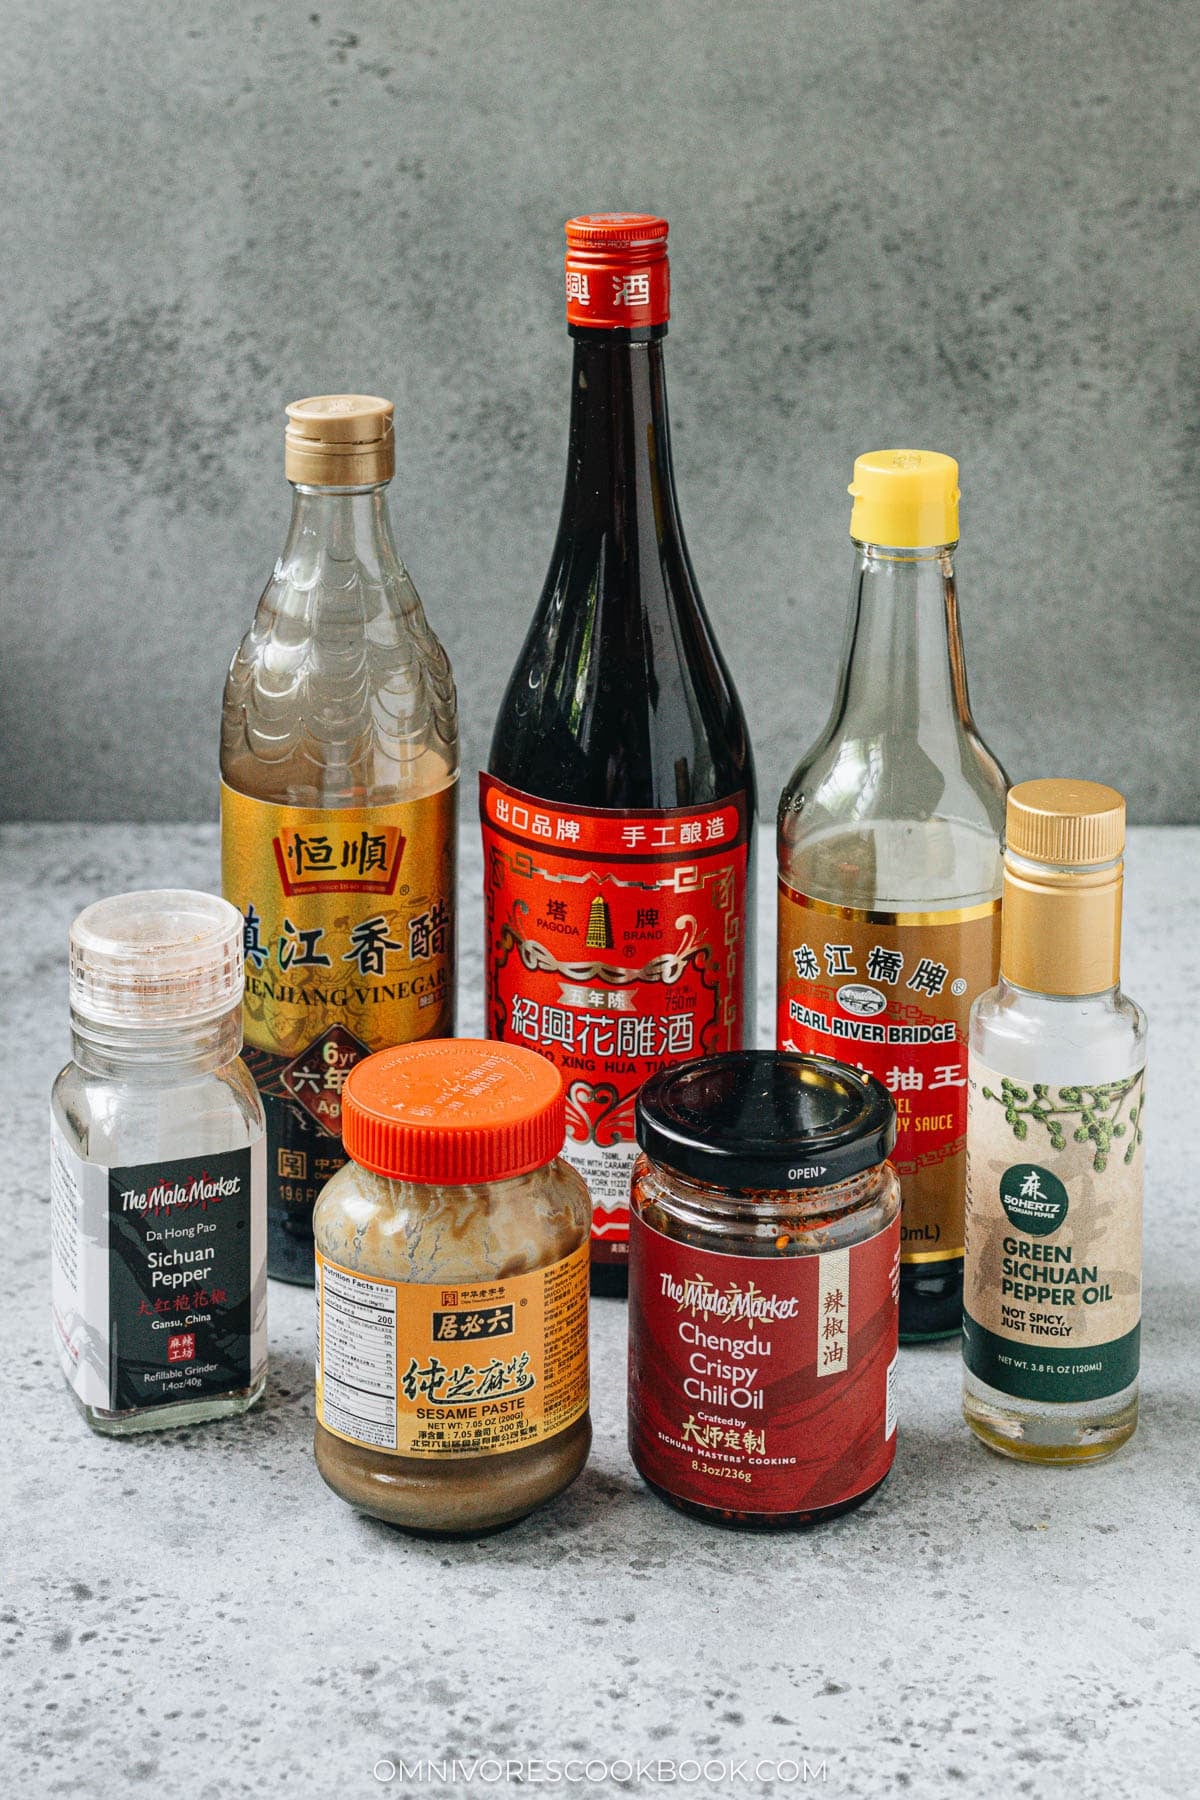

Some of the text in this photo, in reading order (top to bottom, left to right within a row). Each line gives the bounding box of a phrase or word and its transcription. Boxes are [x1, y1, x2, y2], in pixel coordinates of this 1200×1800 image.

[496, 798, 726, 848] 出口品牌 手工酿造
[635, 908, 659, 929] 牌
[537, 919, 663, 941] PAGODA BRAND
[793, 944, 949, 997] 珠江橋牌
[511, 994, 694, 1058] 紹興花雕酒
[789, 1000, 956, 1044] PEARL RIVER BRIDGE
[323, 1042, 356, 1064] 6yr
[561, 1055, 595, 1071] XING
[605, 1062, 637, 1074] HUA
[317, 1101, 341, 1117] Ag
[915, 1113, 953, 1132] SAUCE
[587, 1159, 602, 1167] WITH
[788, 1166, 819, 1180] OPEN
[121, 1176, 241, 1211] The Mala Market
[280, 1185, 303, 1202] 19.6
[146, 1223, 217, 1242] Da Hong Pao
[147, 1247, 215, 1268] Sichuan
[1002, 1237, 1072, 1263] GREEN
[152, 1267, 212, 1289] Pepper
[324, 1265, 350, 1283] Nutrition
[353, 1279, 373, 1290] Facts
[1002, 1258, 1098, 1285] SICHUAN
[660, 1272, 799, 1320] The Mala Market
[1002, 1278, 1113, 1306] PEPPER OIL
[151, 1314, 212, 1330] Gansu, China
[378, 1315, 393, 1325] 200
[823, 1289, 846, 1365] 辣椒油
[1001, 1305, 1066, 1327] NOT SPICY,
[1001, 1317, 1072, 1337] JUST TINGLY
[678, 1322, 772, 1360] Chengdu
[144, 1363, 218, 1383] Refillable Grinder
[690, 1352, 758, 1387] Crispy
[998, 1354, 1103, 1375] NET WT. 3.8 FL OZ (120ML)
[162, 1378, 202, 1392] 1.4oz/40g
[683, 1378, 764, 1410] Chili Oil
[416, 1407, 477, 1420] SESAME
[482, 1397, 525, 1416] PASTE
[428, 1411, 524, 1430] NET WT: 7.05 OZ (200G)
[697, 1412, 746, 1429] Crafted by
[453, 1430, 472, 1439] 7.05
[680, 1414, 766, 1456] 大师定制
[658, 1432, 797, 1465] SICHUAN MASTERS' COOKING
[691, 1460, 752, 1483] 8.3oz/236g
